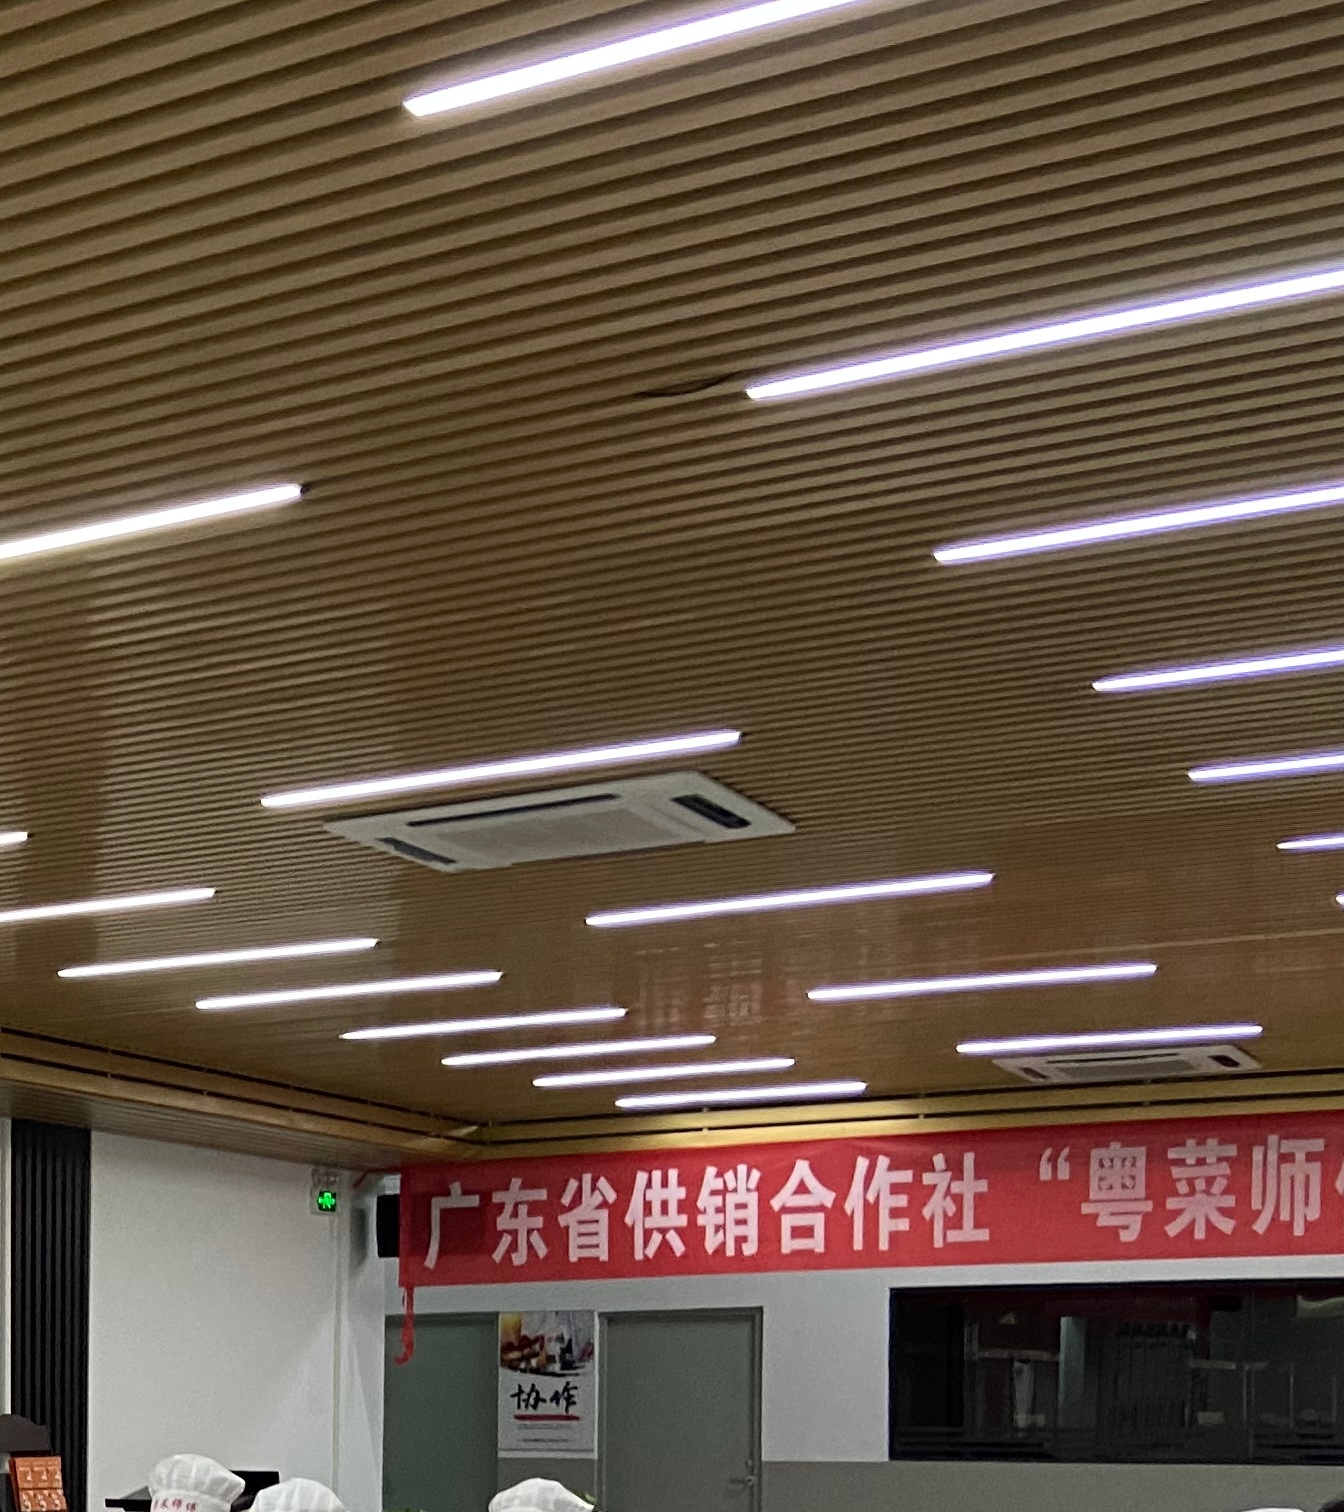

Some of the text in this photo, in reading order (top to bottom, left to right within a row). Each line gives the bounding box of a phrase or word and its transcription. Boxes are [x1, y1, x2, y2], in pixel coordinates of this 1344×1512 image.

[424, 1134, 1344, 1270] 广东省供销合作社“粤菜师
[510, 1381, 579, 1415] 协作
